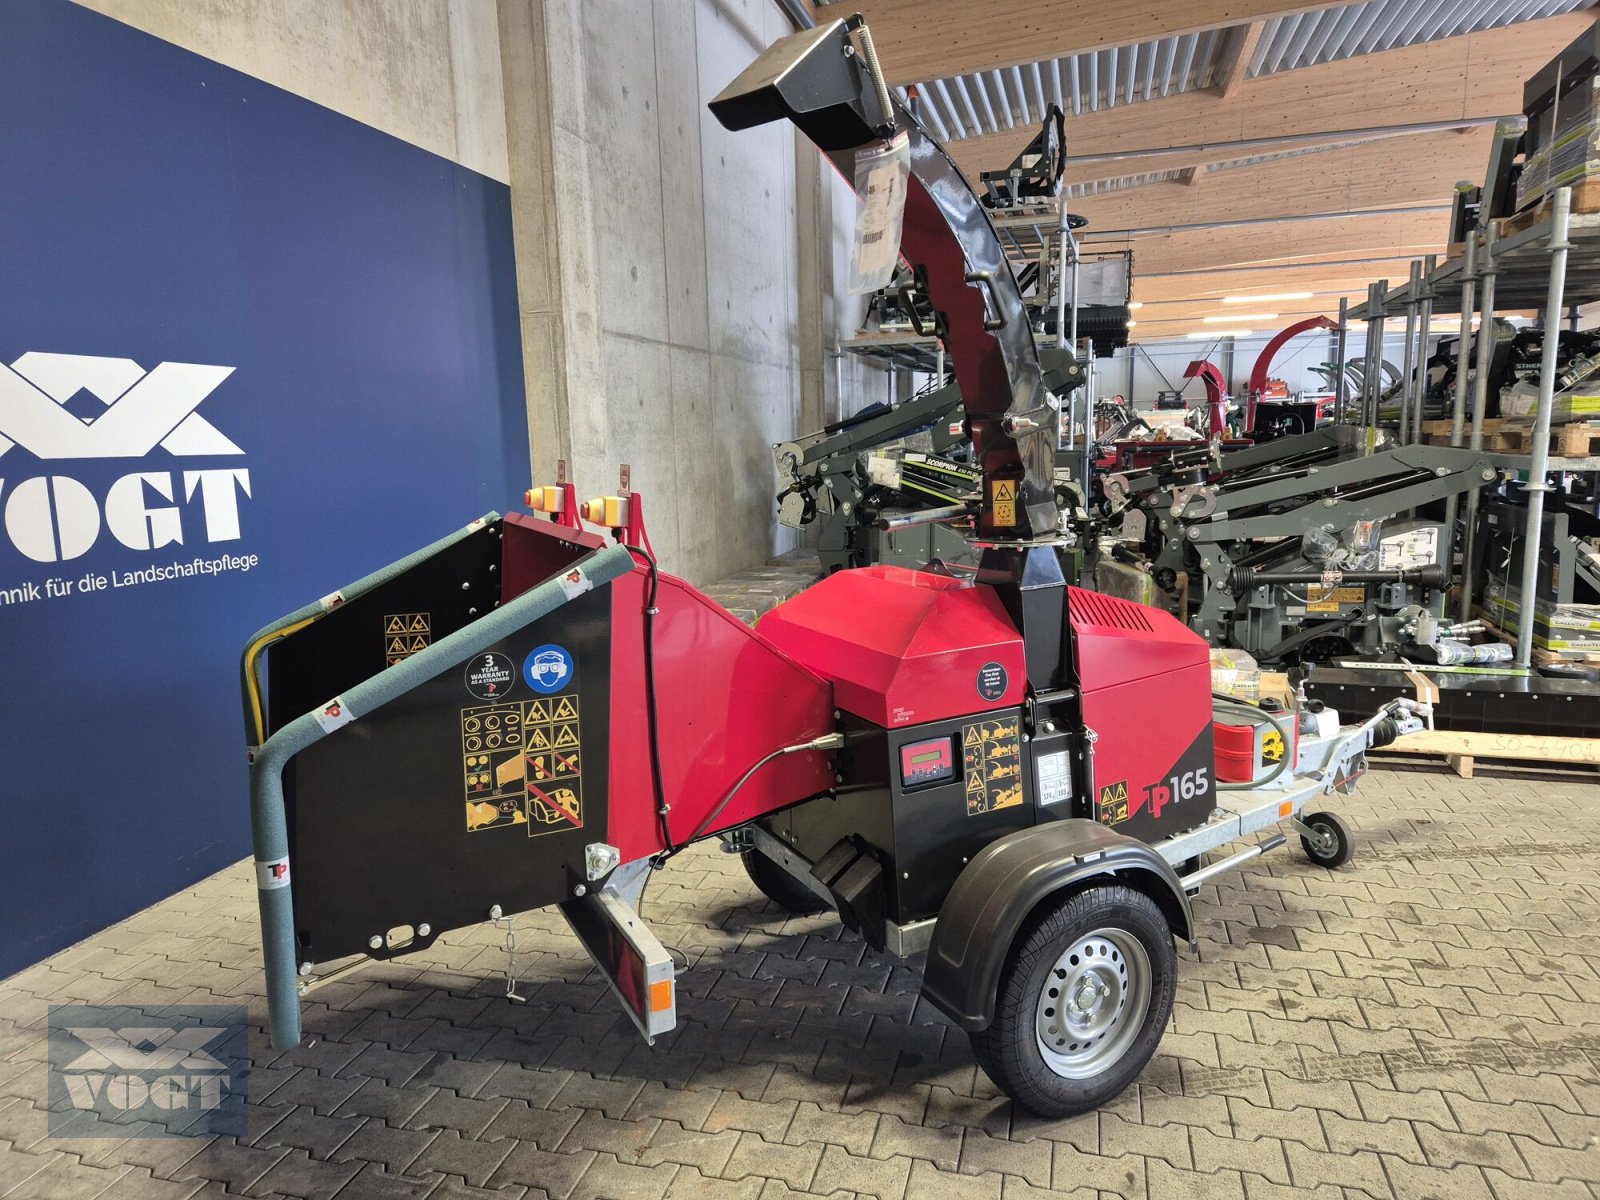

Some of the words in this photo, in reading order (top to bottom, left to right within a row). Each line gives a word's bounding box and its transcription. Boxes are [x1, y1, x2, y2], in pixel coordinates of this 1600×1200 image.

[926, 458, 958, 472] SCORPION
[0, 468, 252, 563] OGT
[45, 577, 73, 598] für
[78, 572, 107, 593] die
[112, 554, 259, 588] Landschaftspflege
[485, 655, 494, 666] 3
[470, 670, 510, 680] WARRANTY
[267, 863, 287, 880] TP
